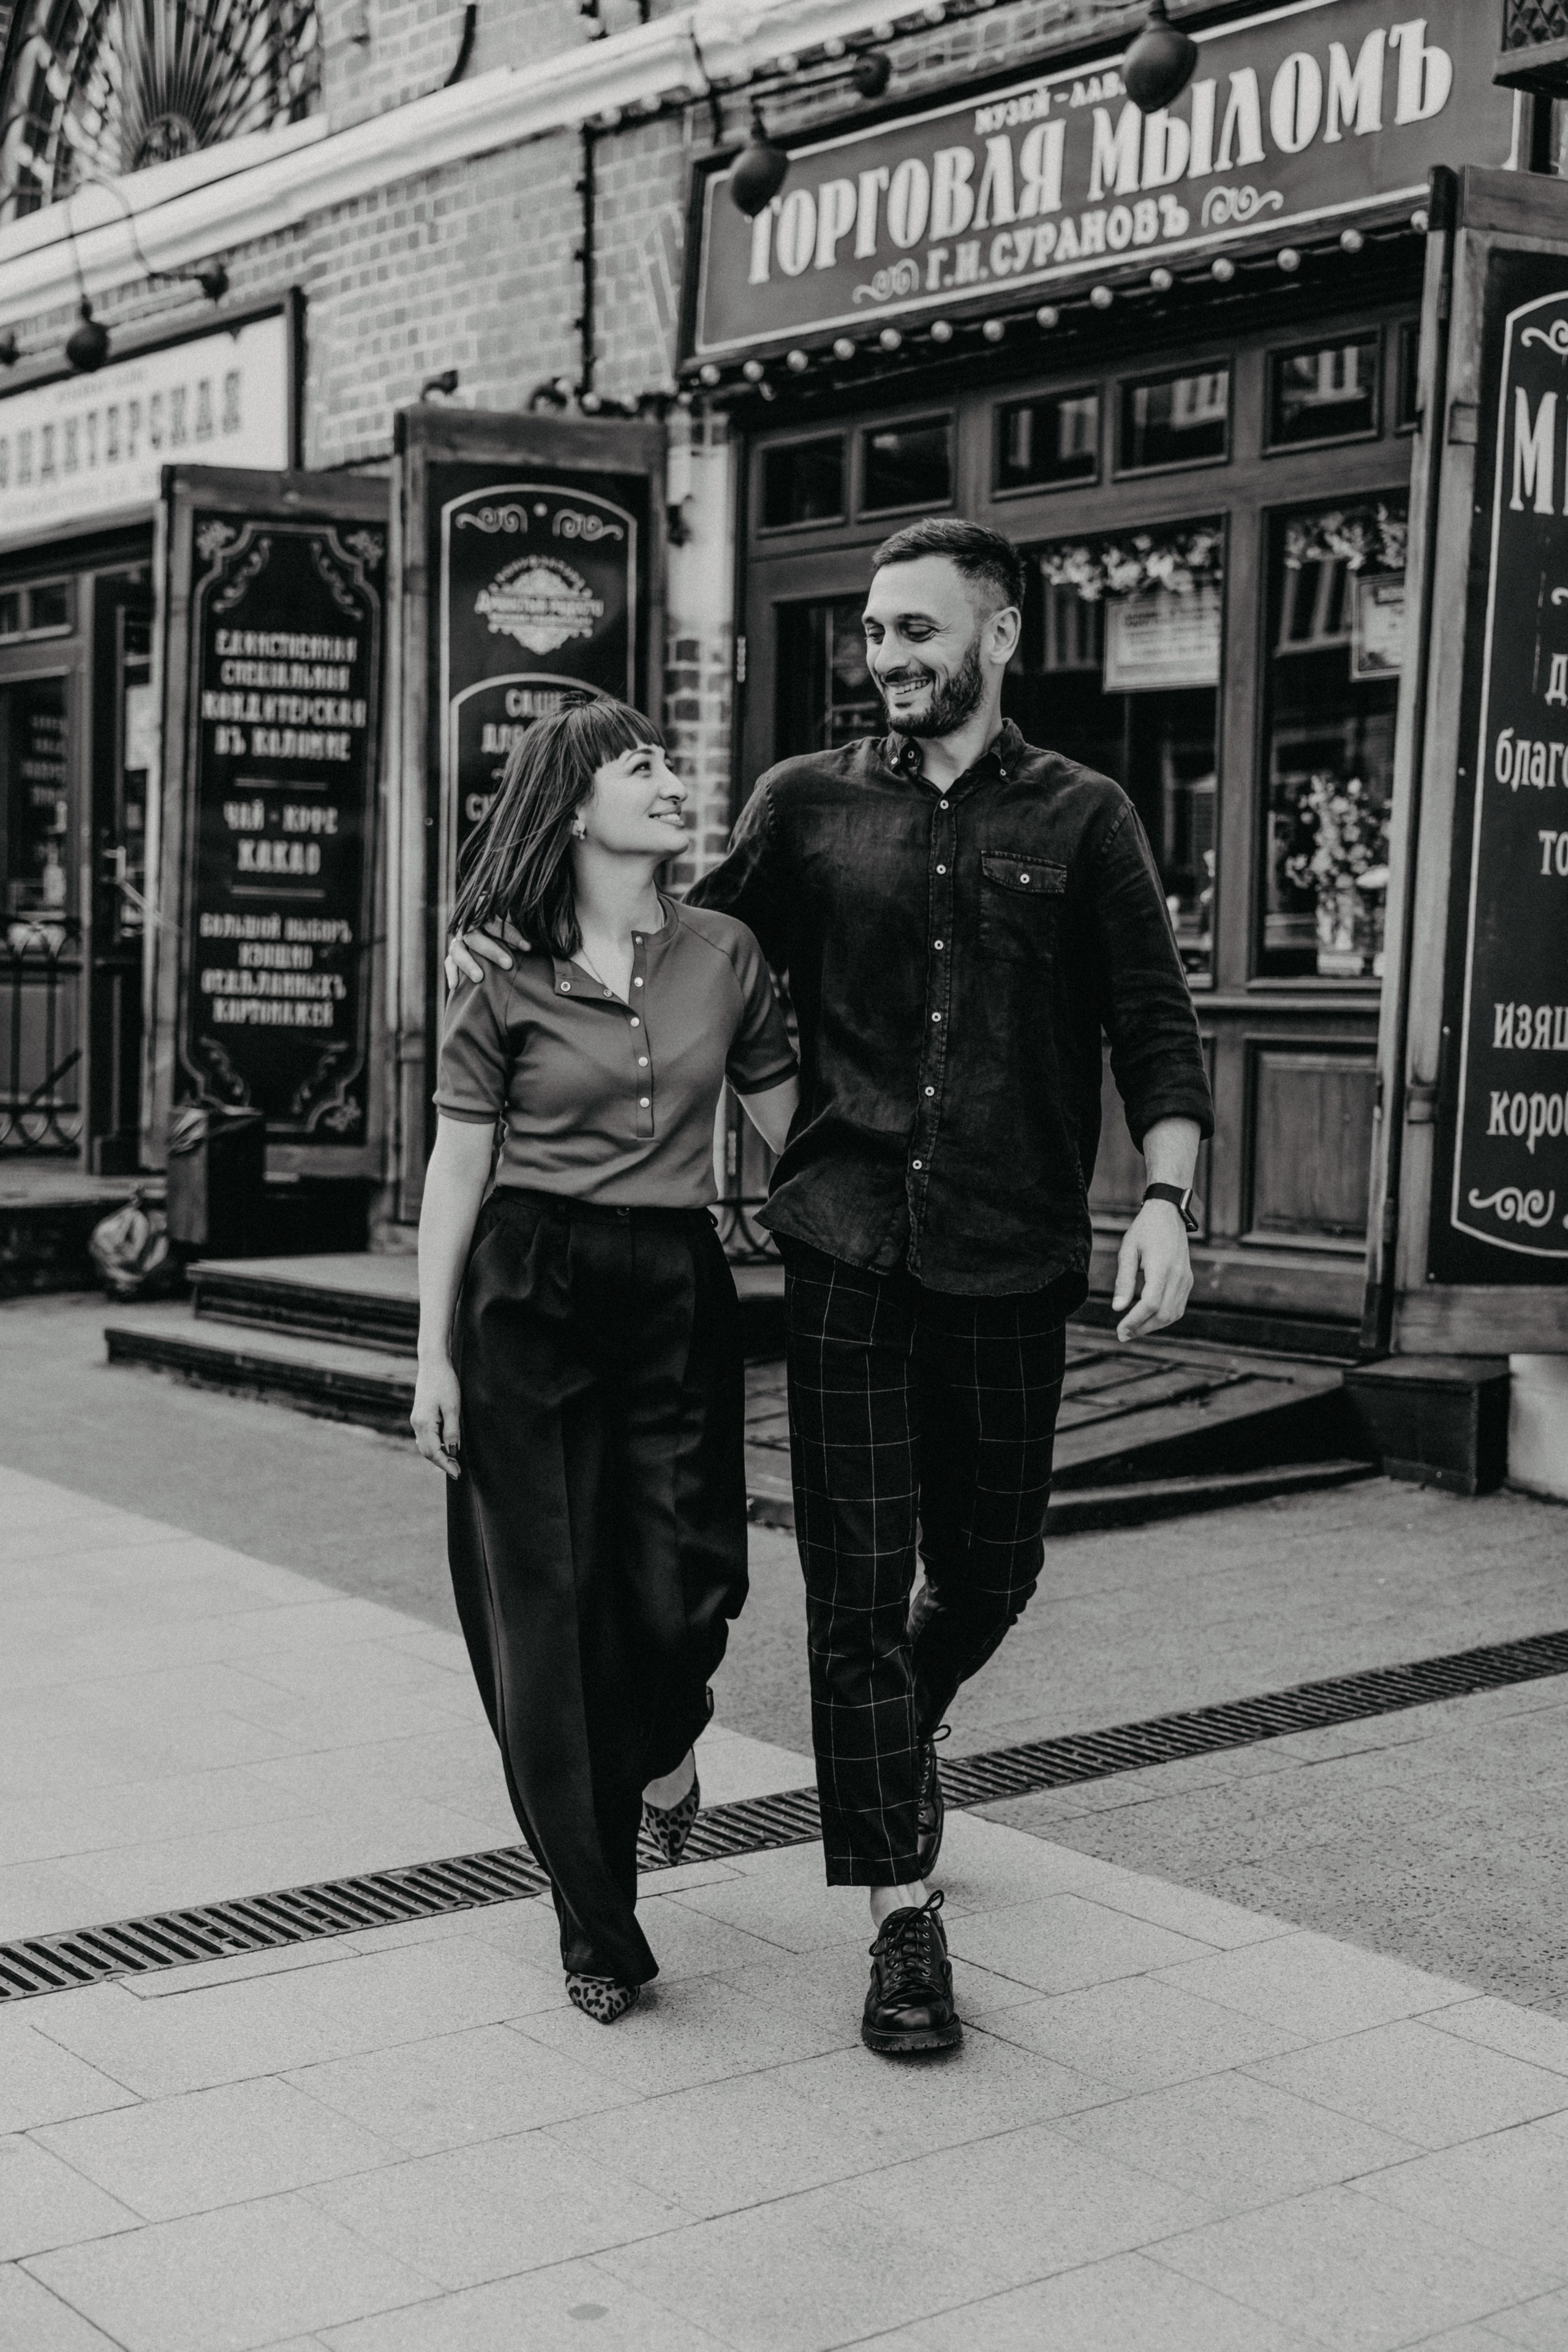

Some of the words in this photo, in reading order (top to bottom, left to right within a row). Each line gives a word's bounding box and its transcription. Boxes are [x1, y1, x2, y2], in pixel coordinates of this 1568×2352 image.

[974, 71, 1128, 135] МУЗЕЙ-ЛАВ
[744, 119, 1067, 284] ТОРГОВЛЯ
[1087, 18, 1453, 202] МЫЛОМЪ
[990, 193, 1189, 277] СУРАНОВЪ
[1509, 386, 1568, 516] М
[1487, 1090, 1568, 1155] коро
